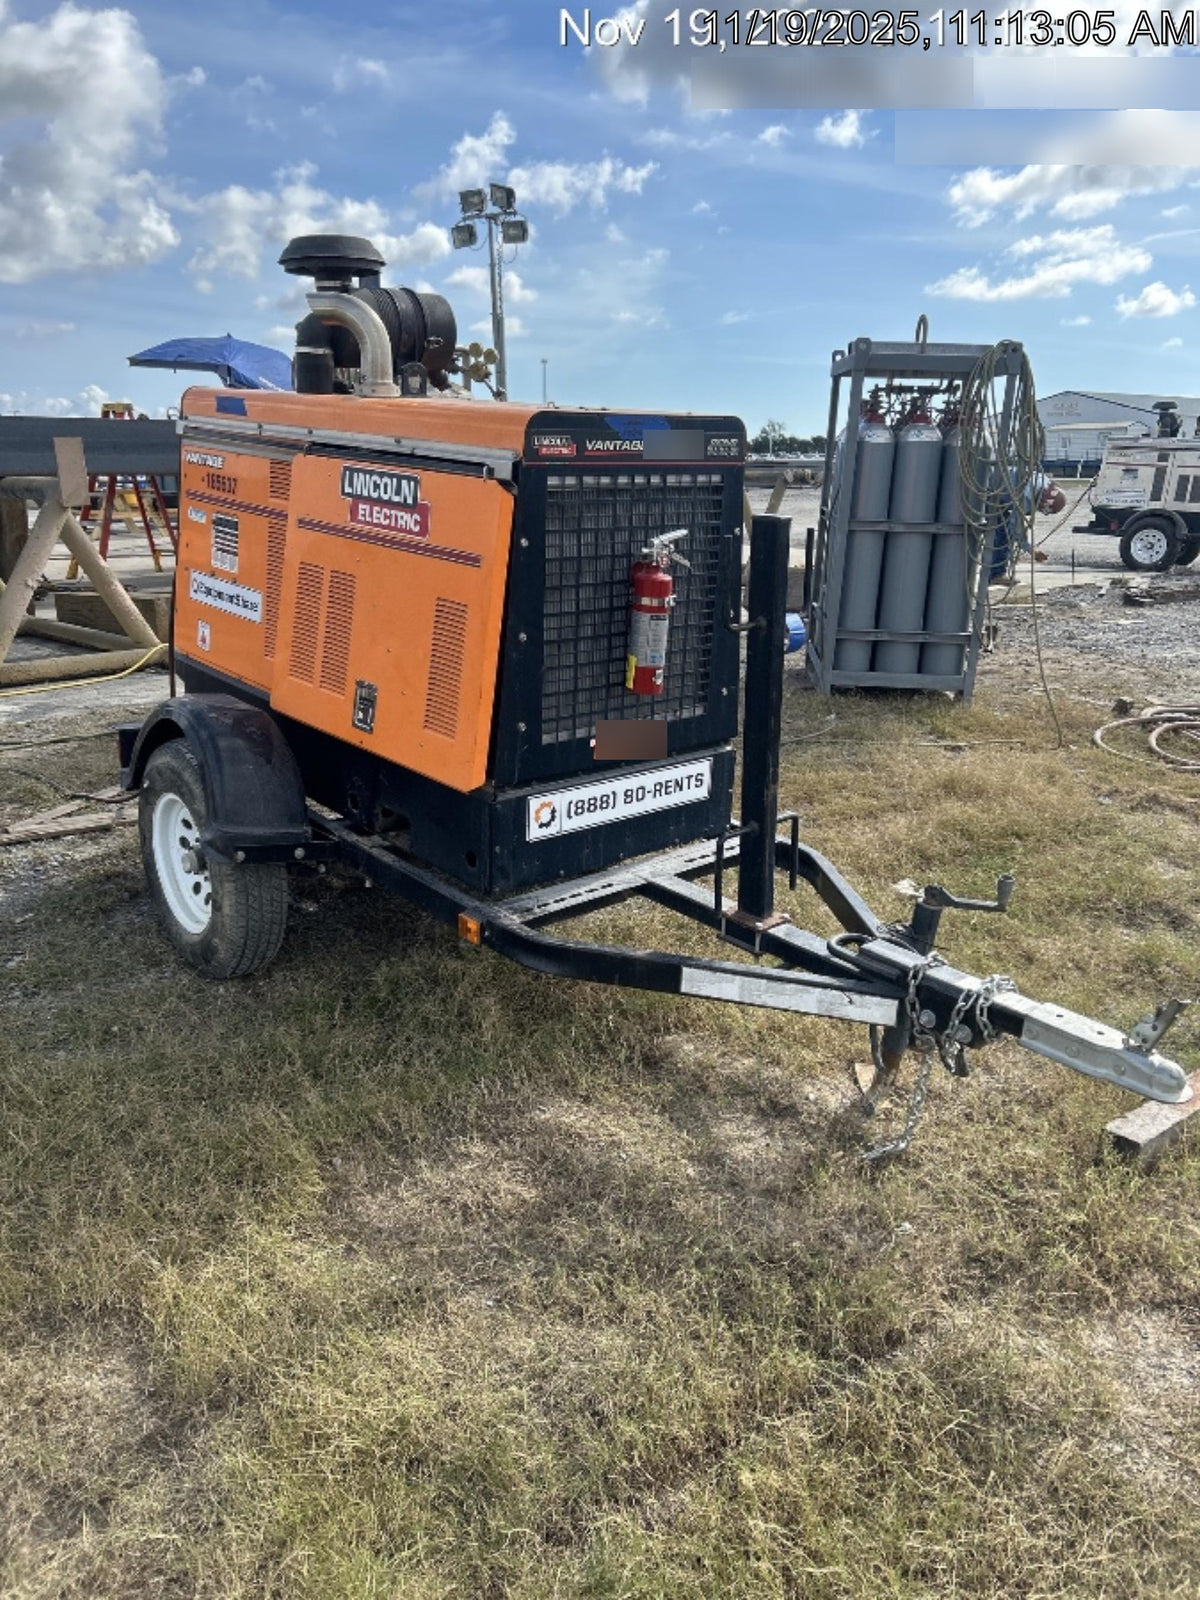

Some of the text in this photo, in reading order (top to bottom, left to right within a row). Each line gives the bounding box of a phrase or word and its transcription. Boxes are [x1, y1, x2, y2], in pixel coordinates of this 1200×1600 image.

[586, 439, 643, 451] VANTAG
[344, 470, 415, 505] LINCOLN
[358, 503, 421, 532] ELECTRIC
[567, 791, 618, 820] (888)
